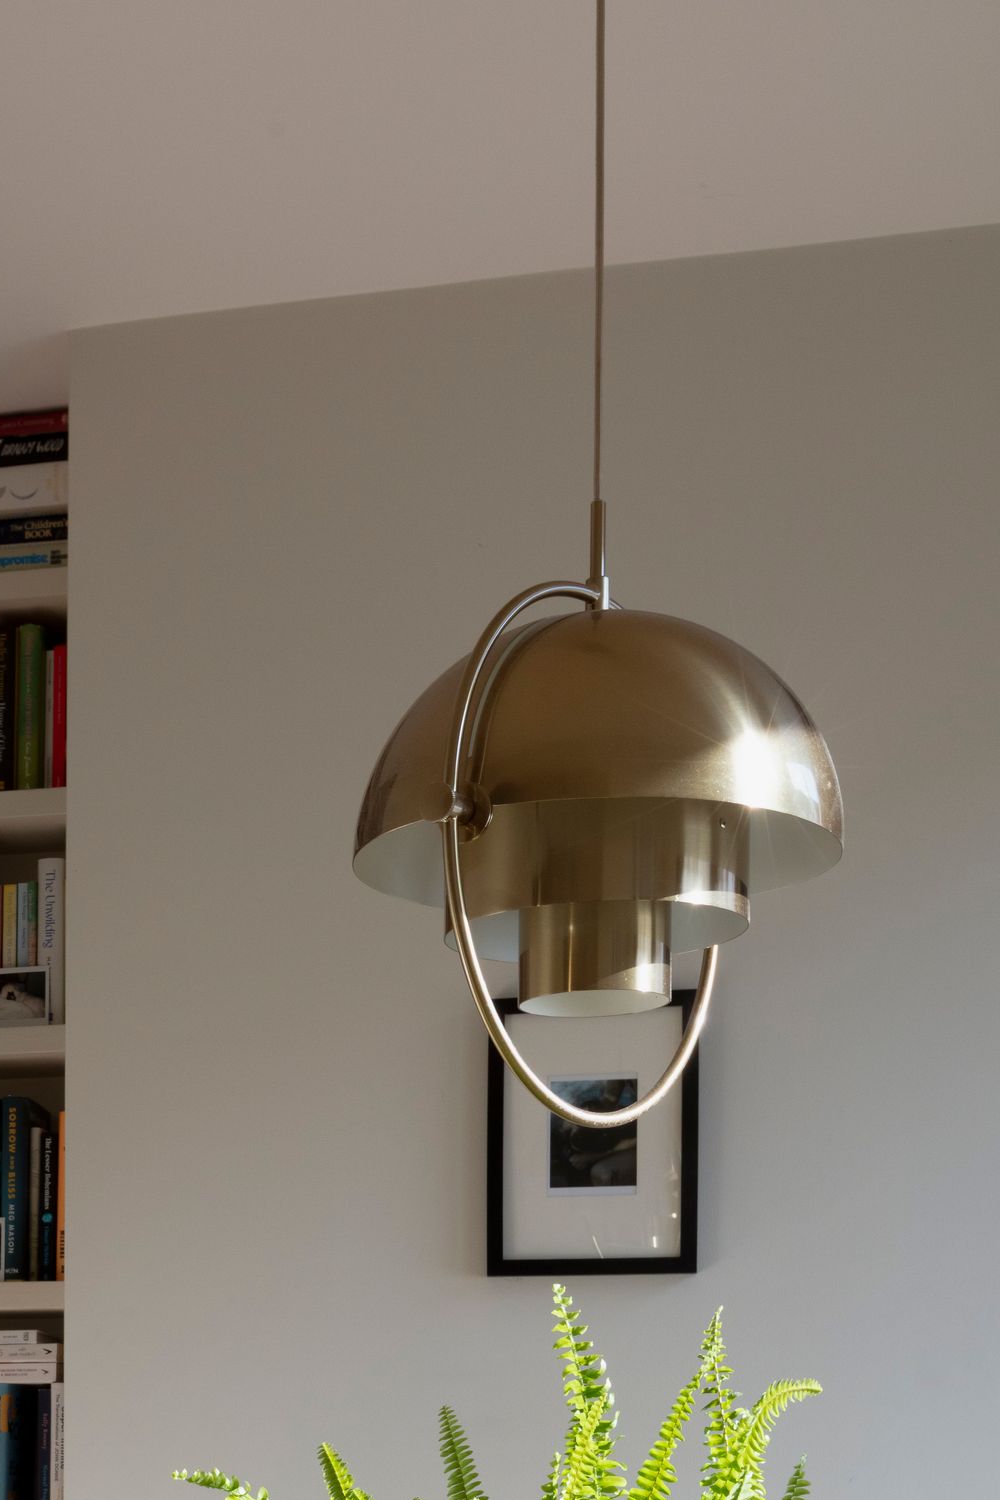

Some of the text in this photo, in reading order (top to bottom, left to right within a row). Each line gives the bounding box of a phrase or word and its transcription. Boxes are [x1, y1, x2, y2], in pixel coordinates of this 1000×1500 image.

[35, 439, 64, 454] WOOD
[44, 870, 57, 948] The Unwilding
[8, 1107, 17, 1152] SORROW
[8, 1172, 16, 1198] BLISS
